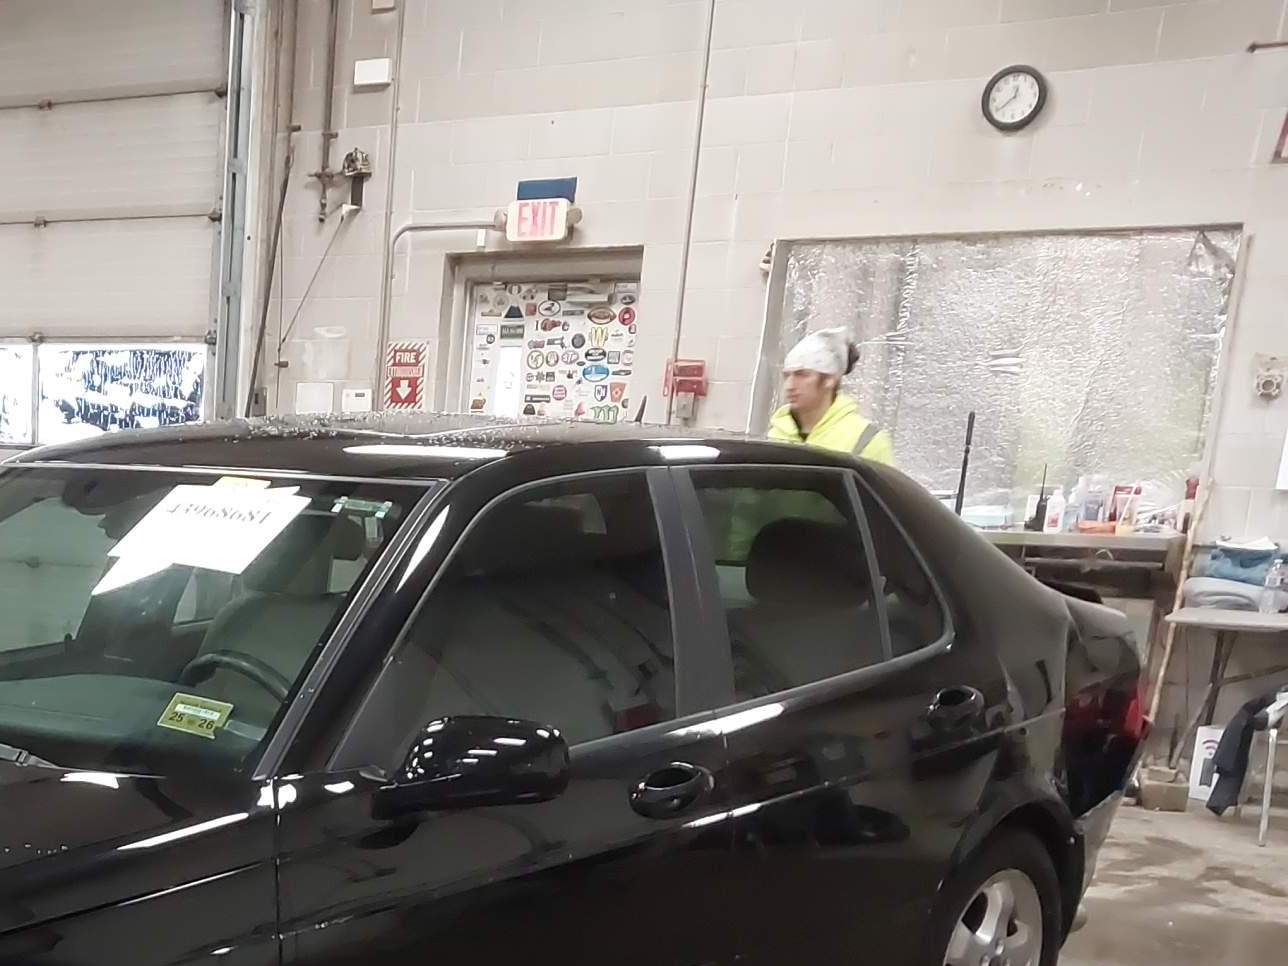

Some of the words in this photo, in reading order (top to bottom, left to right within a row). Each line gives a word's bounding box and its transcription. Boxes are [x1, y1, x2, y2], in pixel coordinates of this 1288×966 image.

[518, 201, 559, 238] EXIT
[395, 351, 417, 364] FIRE
[169, 711, 184, 722] 25
[198, 719, 215, 730] 26
